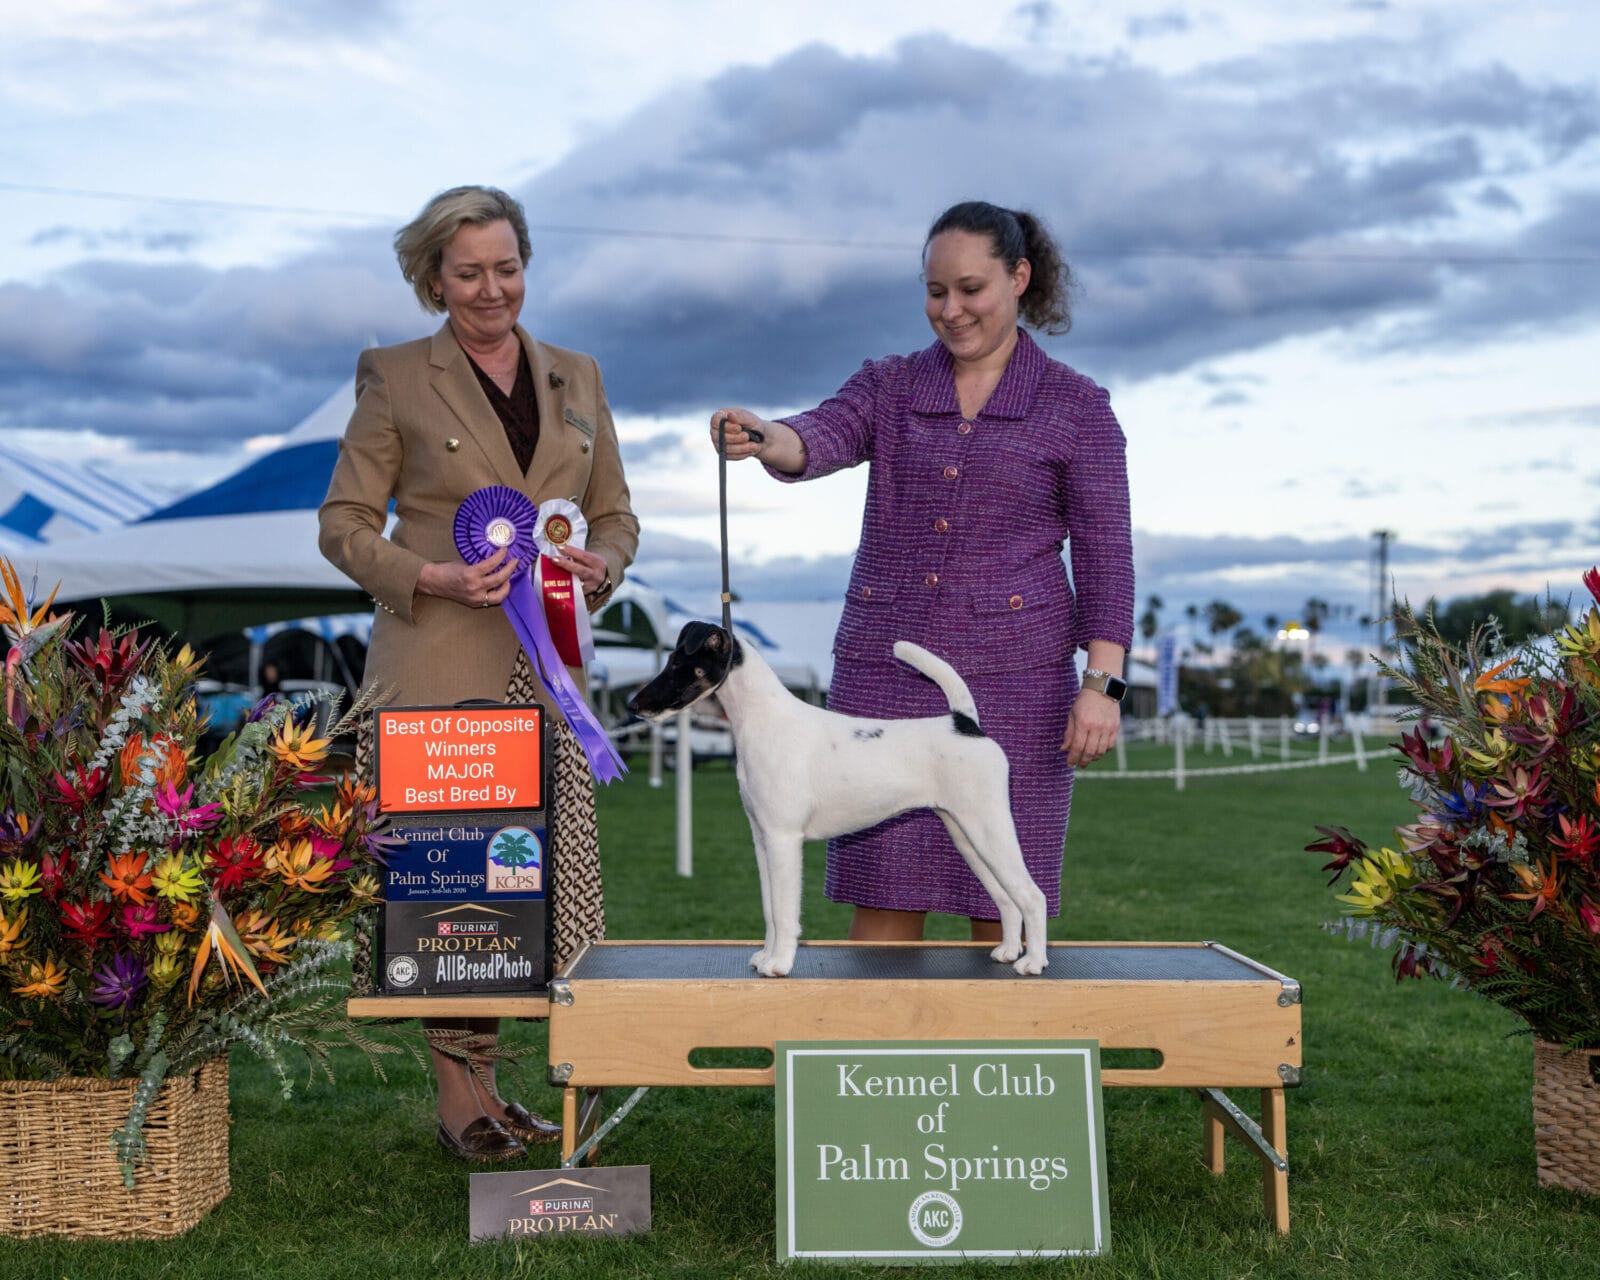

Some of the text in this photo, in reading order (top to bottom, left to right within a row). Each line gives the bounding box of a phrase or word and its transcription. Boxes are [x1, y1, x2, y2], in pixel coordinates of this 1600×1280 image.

[385, 716, 535, 737] Best Of Opposite
[425, 741, 497, 757] Winners
[427, 763, 495, 780] MAJOR
[405, 785, 517, 804] Best Bred By
[392, 827, 485, 841] Kennel Club
[427, 848, 450, 863] Of
[389, 870, 485, 888] Palm Springs
[495, 875, 534, 889] KCPS
[452, 923, 496, 932] PURINA
[416, 936, 518, 952] PRO PLAN
[395, 965, 410, 976] AKC
[436, 952, 532, 984] AllBreedPhoto
[836, 1063, 1056, 1097] Kennel Club
[916, 1102, 950, 1134] of
[816, 1143, 1069, 1191] Palm Springs
[545, 1200, 590, 1211] PURINA
[508, 1213, 615, 1235] PRO PLAN
[923, 1210, 949, 1228] AKC
